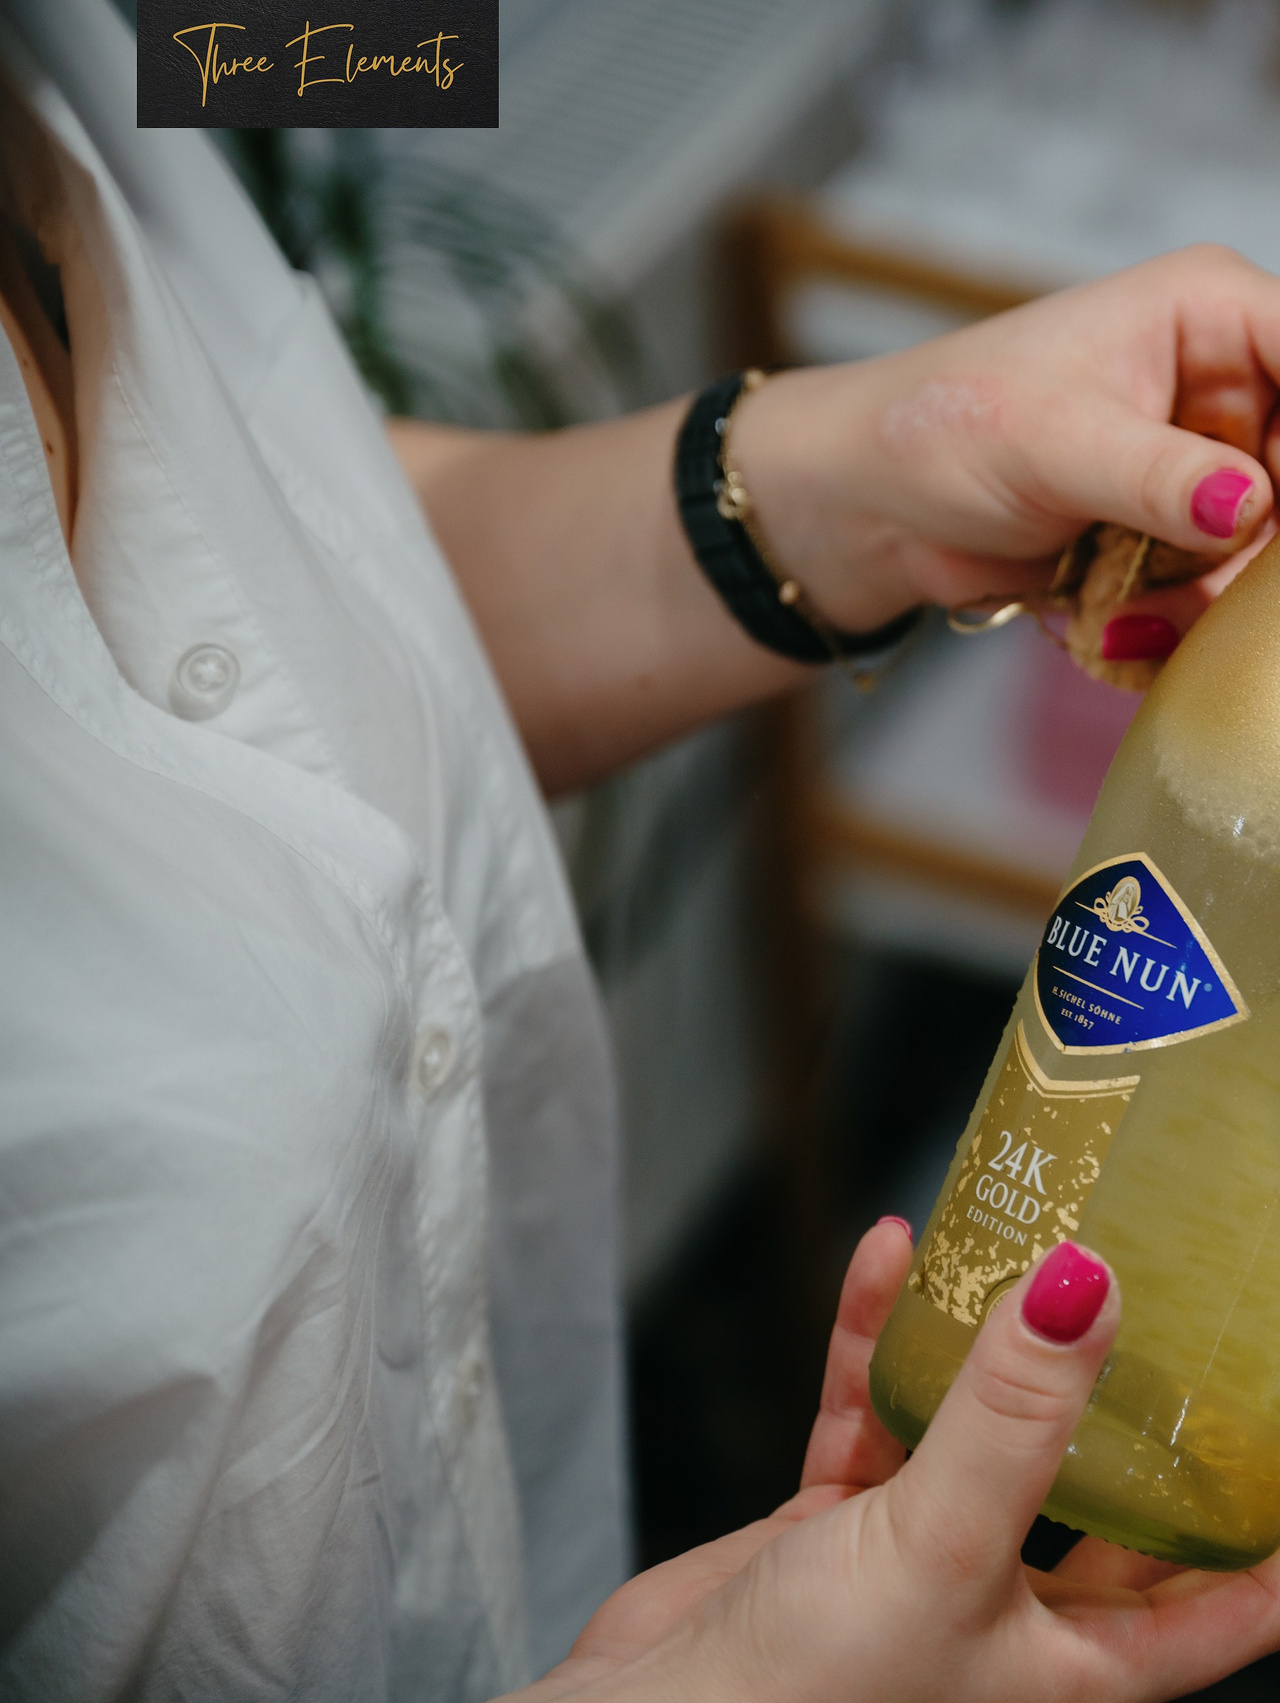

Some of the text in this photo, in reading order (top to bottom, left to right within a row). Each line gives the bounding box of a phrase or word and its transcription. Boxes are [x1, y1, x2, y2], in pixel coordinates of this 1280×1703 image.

[1046, 915, 1108, 967] BLUE
[1073, 1014, 1095, 1030] 1857
[987, 1130, 1058, 1196] 24K
[975, 1174, 1041, 1225] GOLD
[966, 1204, 1028, 1247] EDITION
